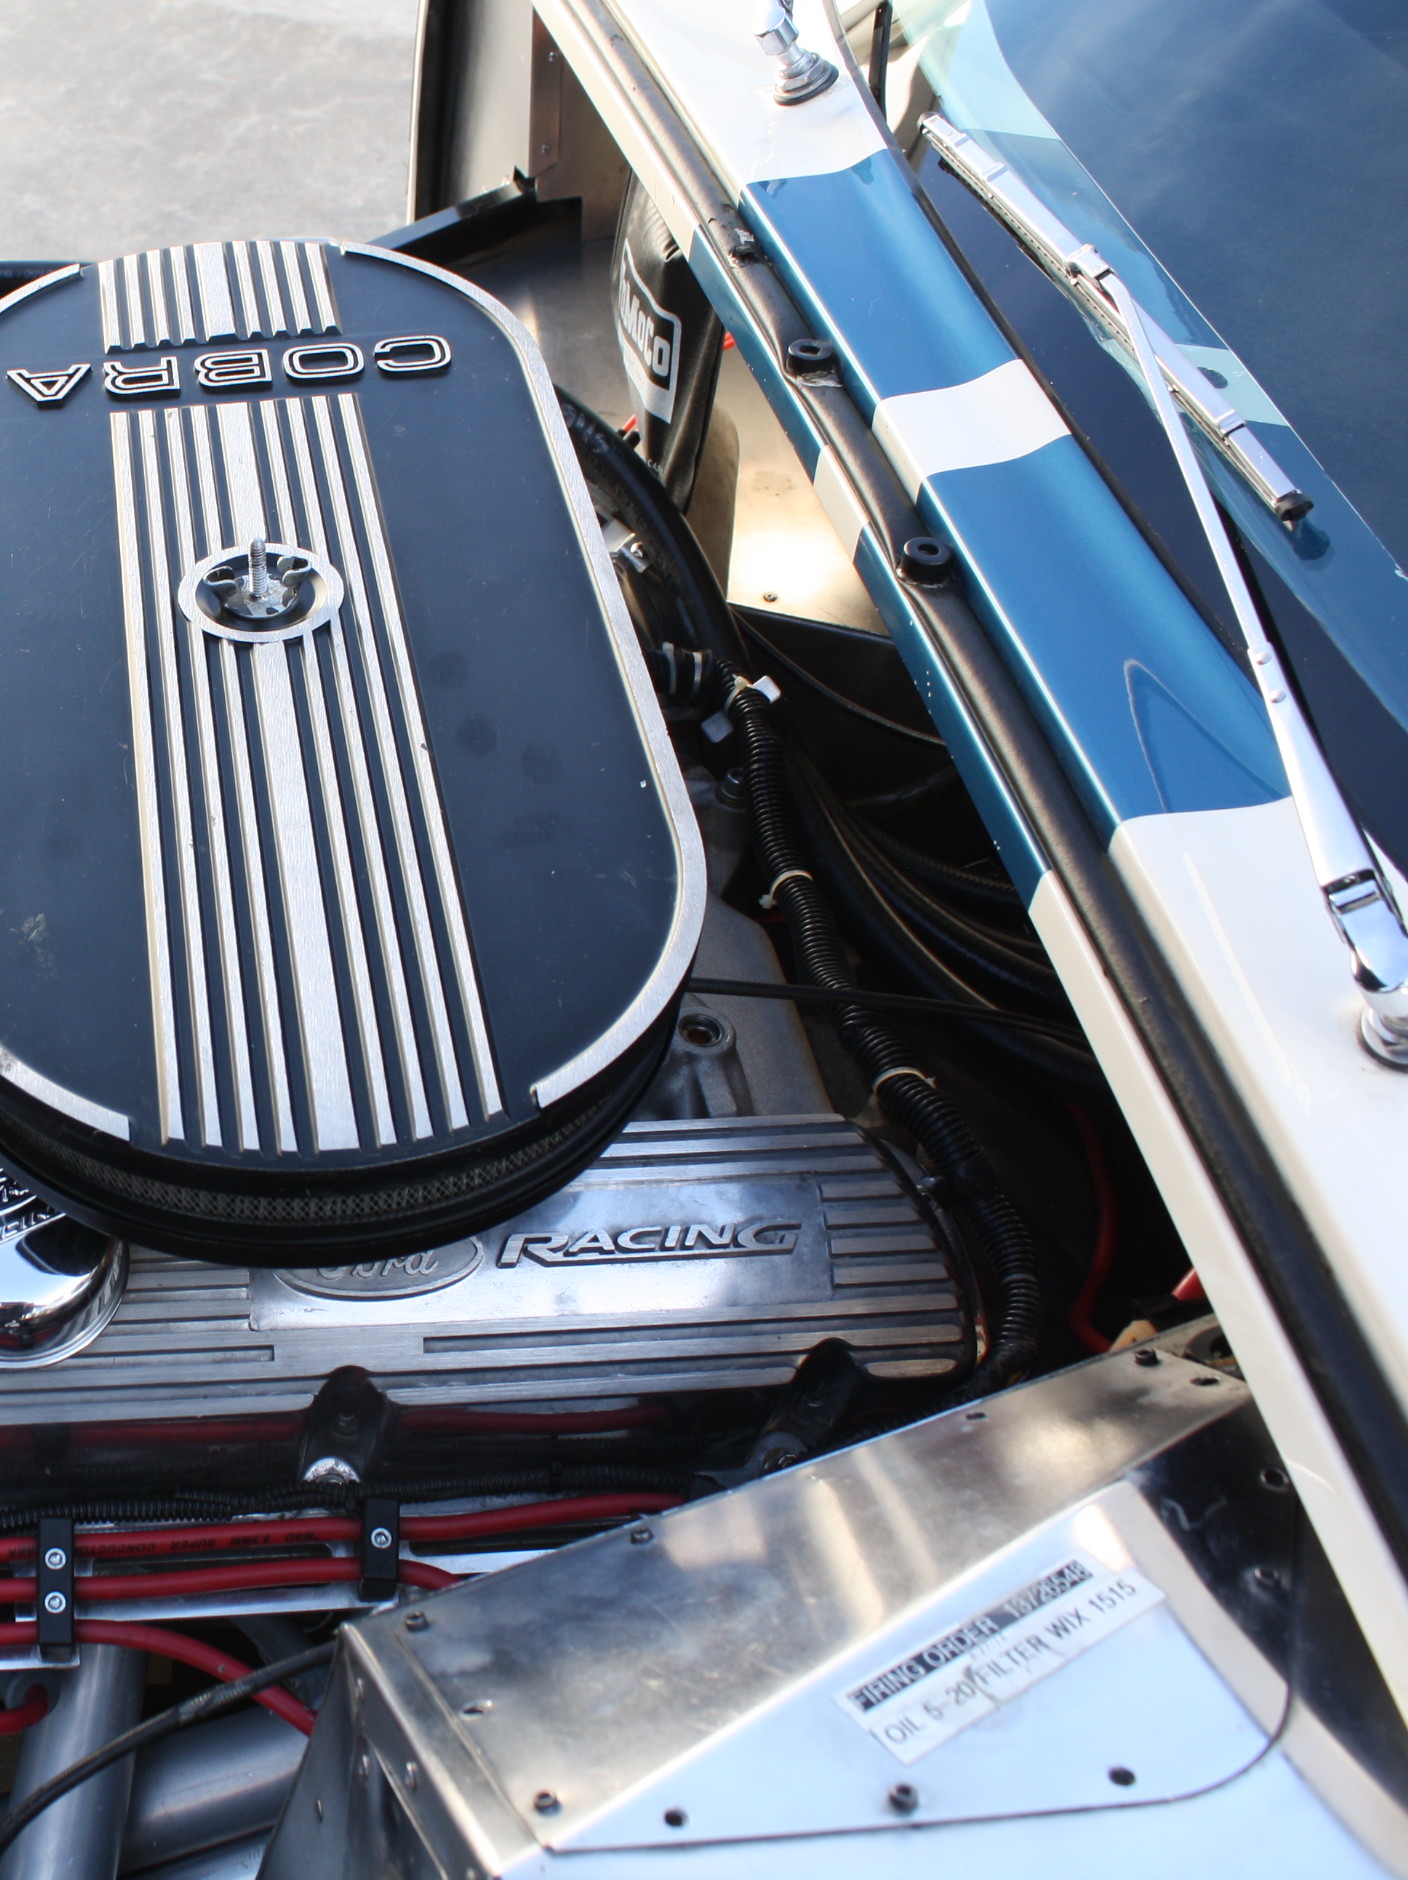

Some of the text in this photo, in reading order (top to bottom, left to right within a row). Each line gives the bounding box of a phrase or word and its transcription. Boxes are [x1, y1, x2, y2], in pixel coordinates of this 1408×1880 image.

[619, 278, 671, 378] oMoCo
[6, 334, 453, 404] COBRA
[495, 1221, 803, 1269] RACING
[73, 1541, 156, 1556] CONDUCTO
[170, 1538, 217, 1551] SUPER
[848, 1658, 926, 1710] FIRING
[926, 1616, 999, 1667] ORDER
[884, 1714, 927, 1745] OIL
[975, 1634, 1050, 1686] FILTER
[1045, 1608, 1092, 1640] WIX
[1088, 1579, 1136, 1614] 1515
